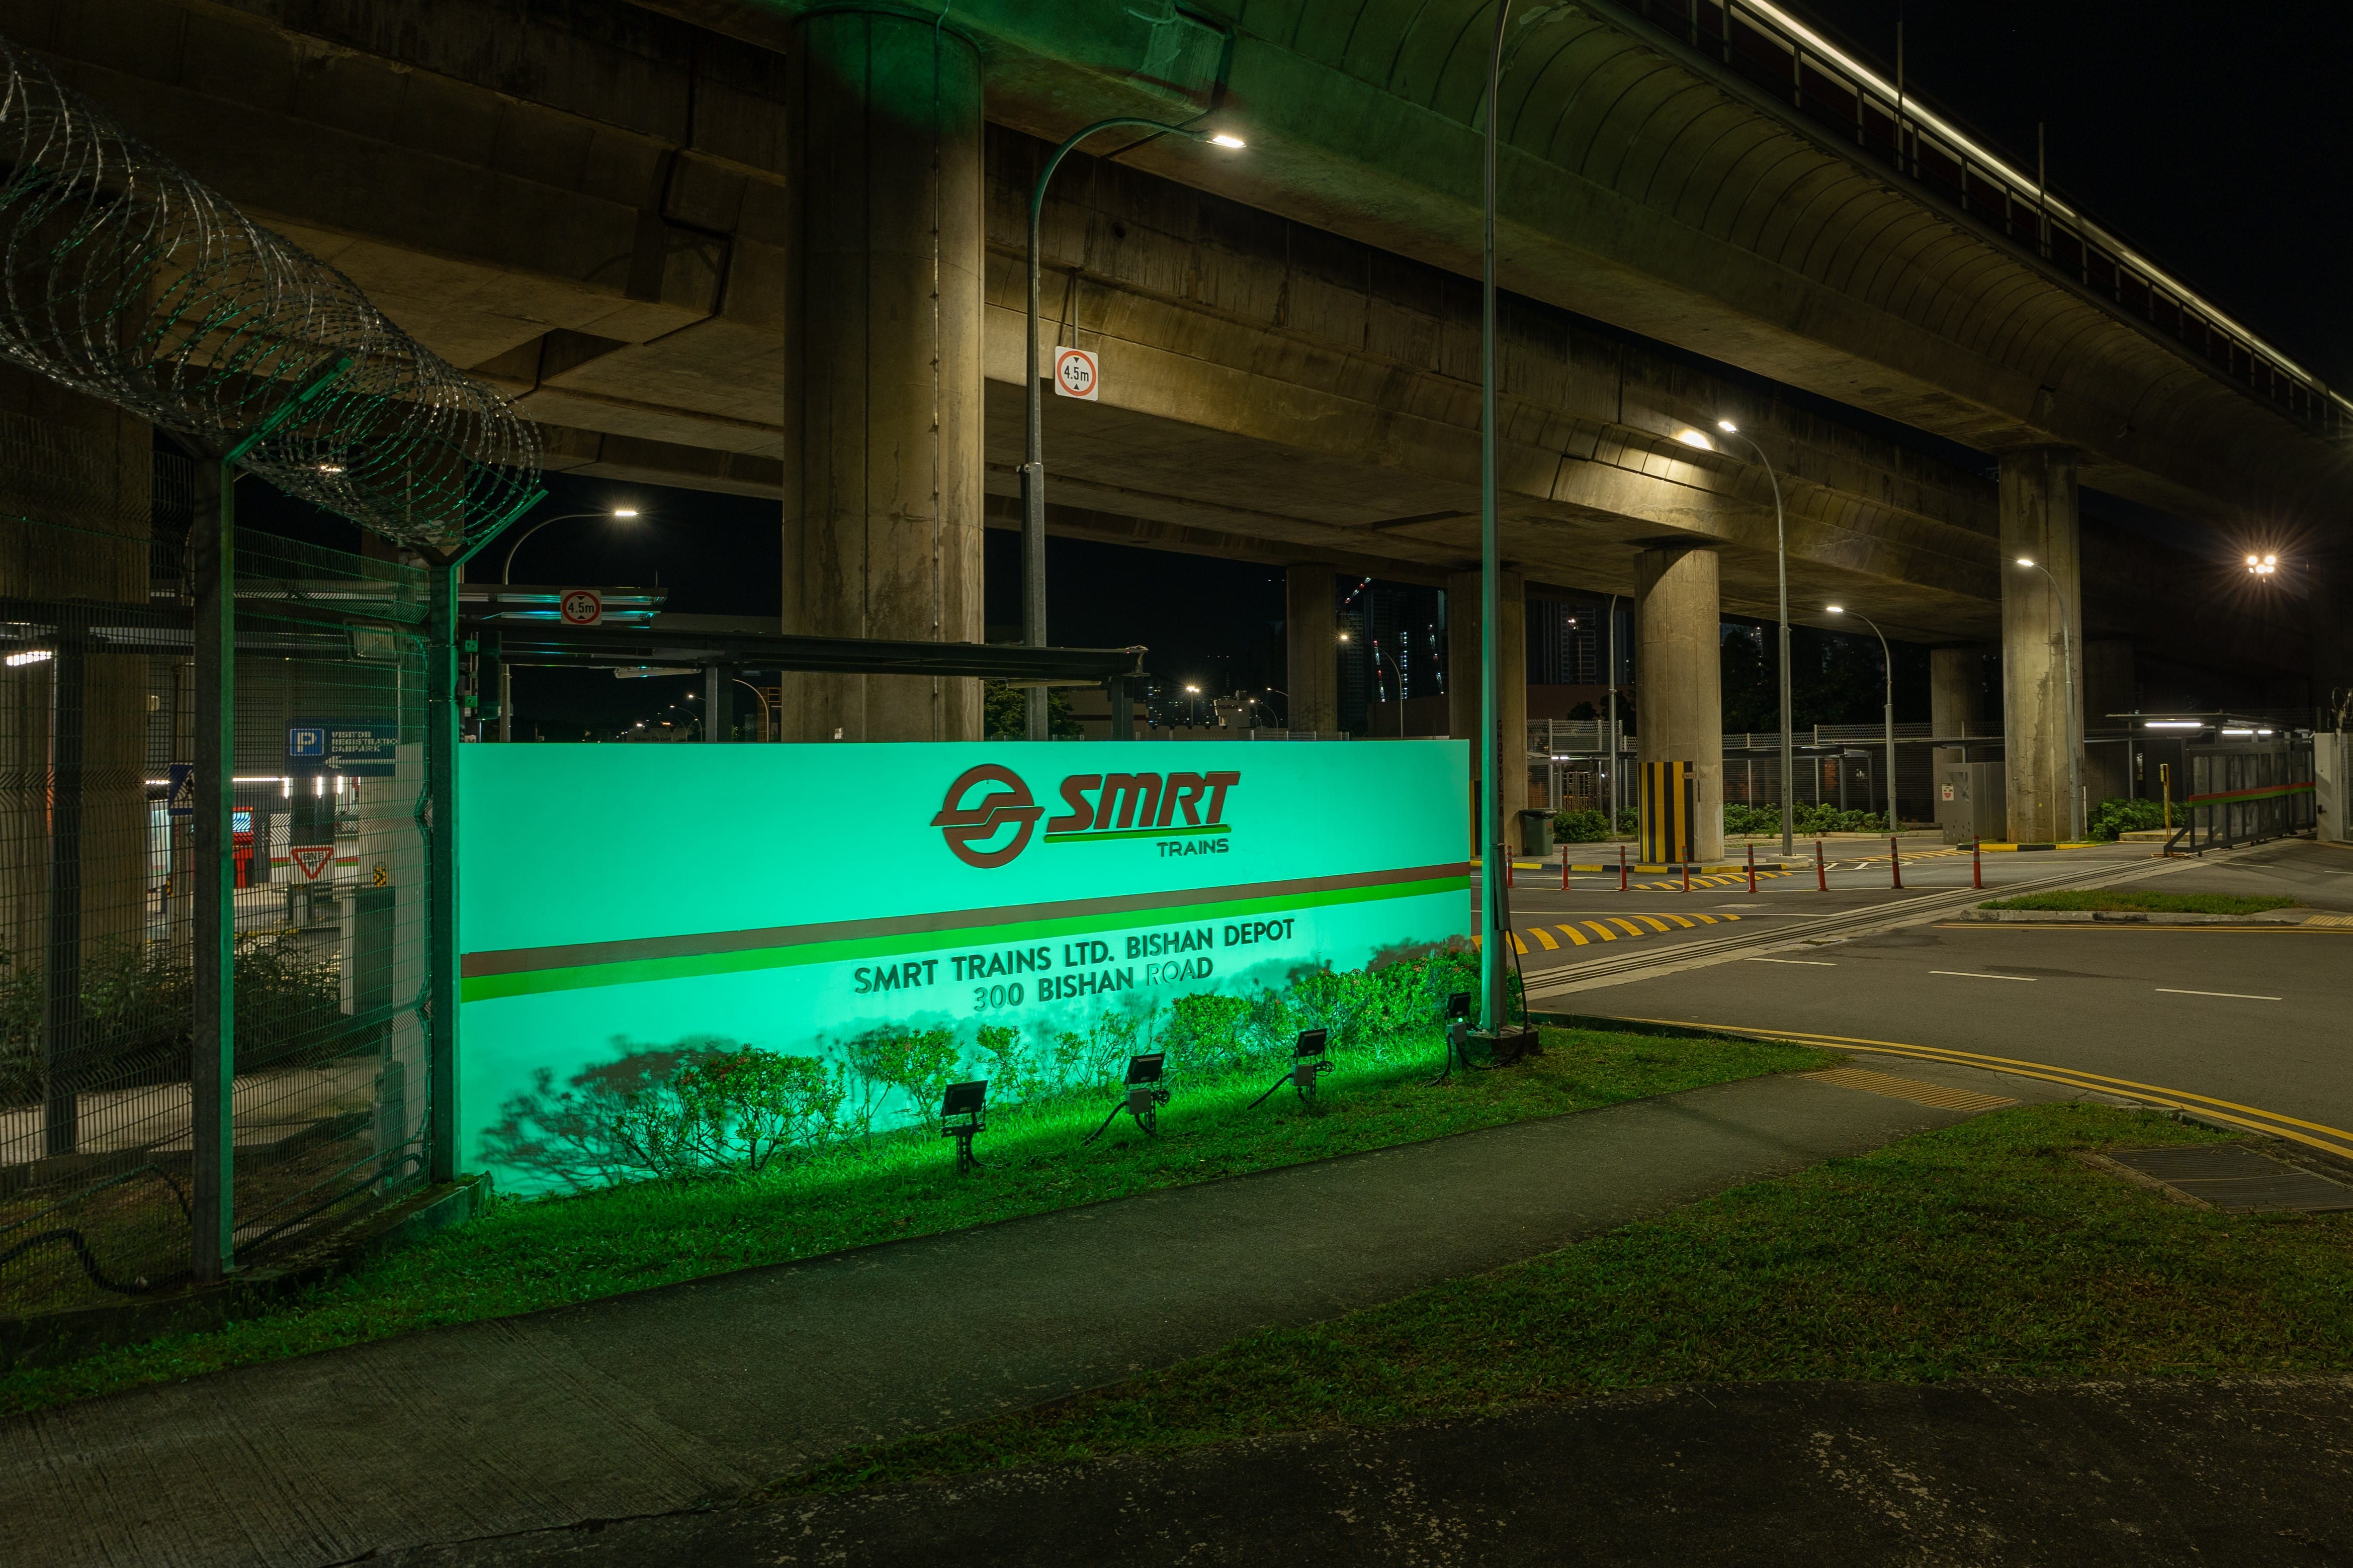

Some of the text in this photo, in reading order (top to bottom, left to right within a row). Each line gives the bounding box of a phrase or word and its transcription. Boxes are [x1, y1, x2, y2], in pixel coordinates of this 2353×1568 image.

[1064, 365, 1089, 382] 4.5m
[568, 602, 594, 613] 4.5m
[297, 732, 316, 753] P
[1047, 771, 1241, 833] SMRT
[1157, 838, 1230, 858] TRAINS
[854, 918, 1295, 994] SMRT TRAINS LTD. BISHAN DEPOT
[974, 957, 1213, 1012] 300 BISHAN ROAD
